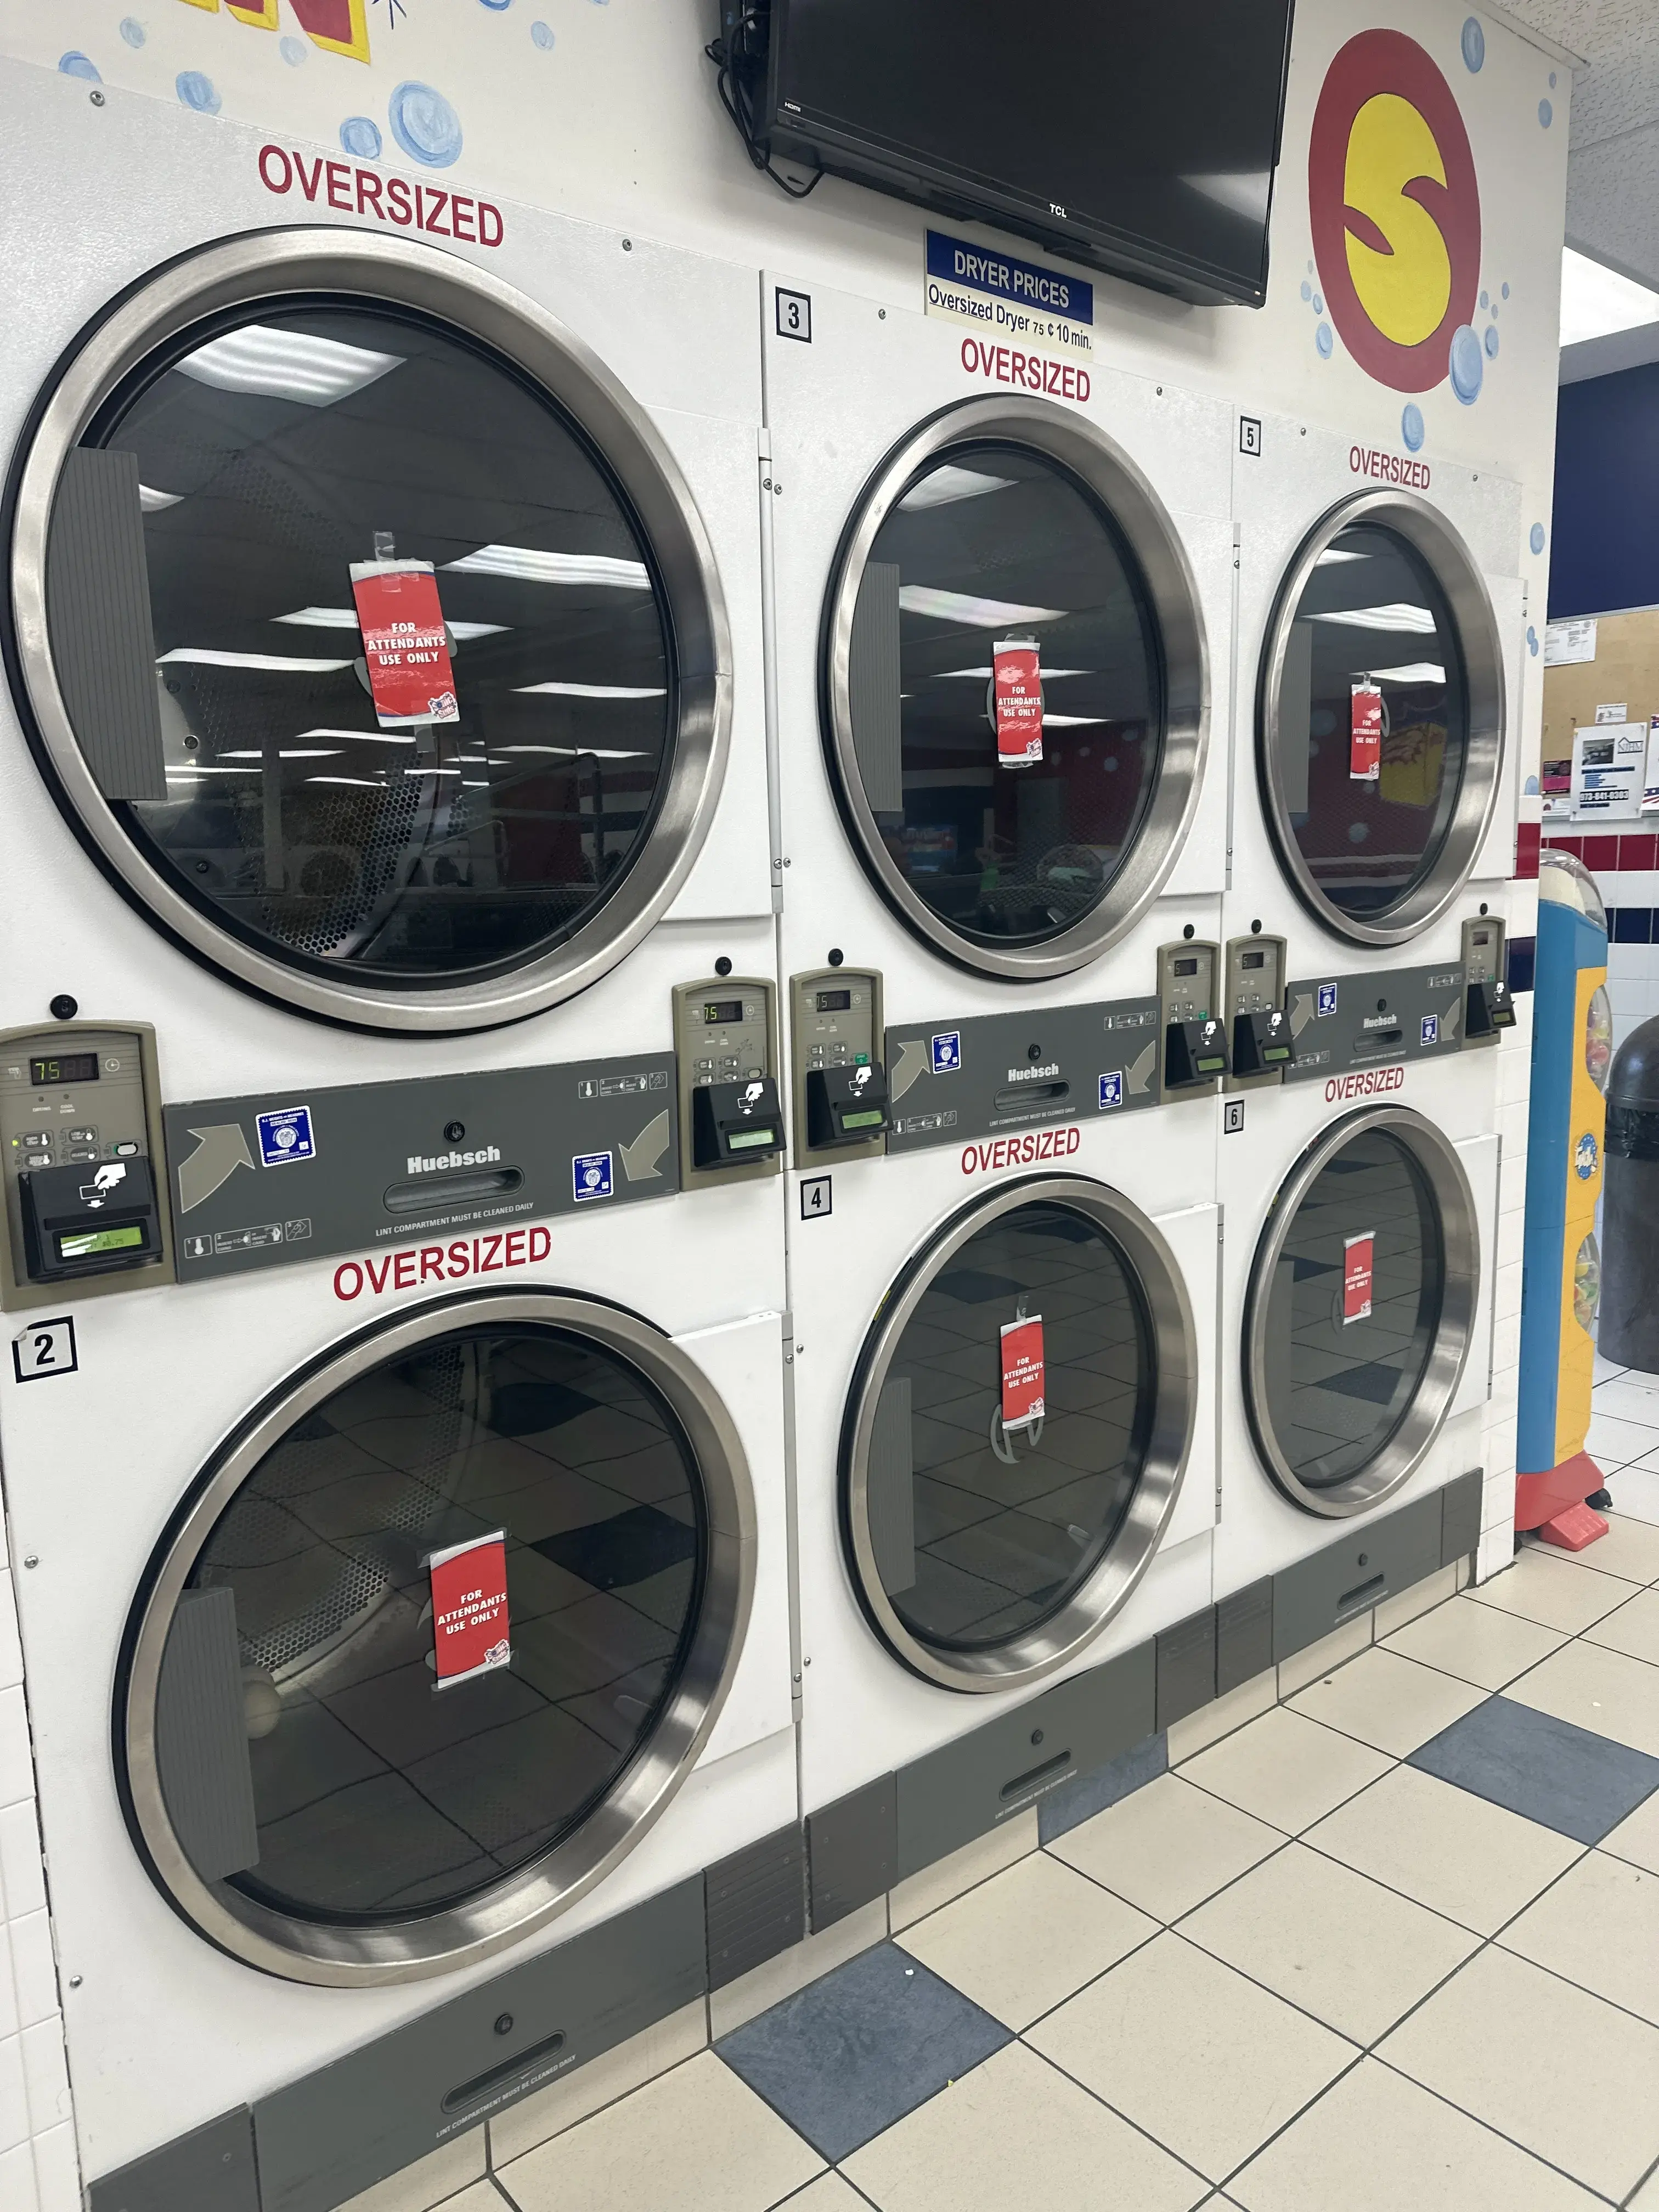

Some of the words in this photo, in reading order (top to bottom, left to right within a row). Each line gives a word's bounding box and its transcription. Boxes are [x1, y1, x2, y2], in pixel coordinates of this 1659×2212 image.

[258, 144, 504, 247] OVERSIZED
[1049, 203, 1067, 218] TCL
[955, 250, 1010, 290] DRYER
[1014, 269, 1069, 308] PRICES
[788, 302, 800, 329] 3
[929, 284, 992, 321] Oversized
[997, 305, 1030, 332] Dryer
[1033, 322, 1044, 335] 75
[1057, 323, 1069, 343] 10
[1071, 329, 1092, 349] min.
[961, 338, 1090, 402] OVERSIZED
[1247, 427, 1254, 447] 5
[1350, 445, 1431, 490] OVERSIZED
[391, 622, 416, 634] FOR
[368, 636, 446, 651] ATTENDANTS
[379, 653, 402, 665] USE
[407, 651, 439, 664] ONLY
[1012, 686, 1025, 695] FOR
[998, 697, 1041, 706] ATTENDANTS
[1003, 709, 1015, 717] USE
[1018, 708, 1036, 716] ONLY
[704, 1007, 717, 1020] 75
[1363, 1014, 1397, 1029] Huebsch
[35, 1062, 59, 1080] 75
[1008, 1063, 1059, 1082] Huebsch
[1325, 1067, 1404, 1102] OVERSIZED
[999, 1115, 1030, 1125] COMPARTMENT
[1232, 1108, 1238, 1126] 6
[407, 1146, 500, 1174] Huebsch
[961, 1127, 1080, 1175] OVERSIZED
[811, 1187, 822, 1209] 4
[376, 1227, 392, 1236] LINT
[394, 1217, 450, 1233] COMPARTMENT
[452, 1214, 472, 1223] MUST
[483, 1206, 514, 1217] CLEANED
[515, 1202, 534, 1211] DAILY
[334, 1227, 551, 1301] OVERSIZED
[35, 1334, 55, 1365] 2
[1004, 1361, 1043, 1381] ATTENDANTS
[1017, 1357, 1030, 1367] FOR
[1008, 1379, 1020, 1389] USE
[1022, 1373, 1039, 1384] ONLY
[460, 1589, 482, 1605] FOR
[438, 1592, 506, 1626] ATTENDANTS
[445, 1621, 466, 1635] USE
[471, 1608, 500, 1626] ONLY
[436, 2124, 451, 2138] LINT
[452, 2097, 501, 2129] COMPARTMENT
[502, 2087, 521, 2101] MUST
[522, 2081, 531, 2090] BE
[531, 2064, 558, 2084] CLEANED
[559, 2054, 577, 2068] DAILY
